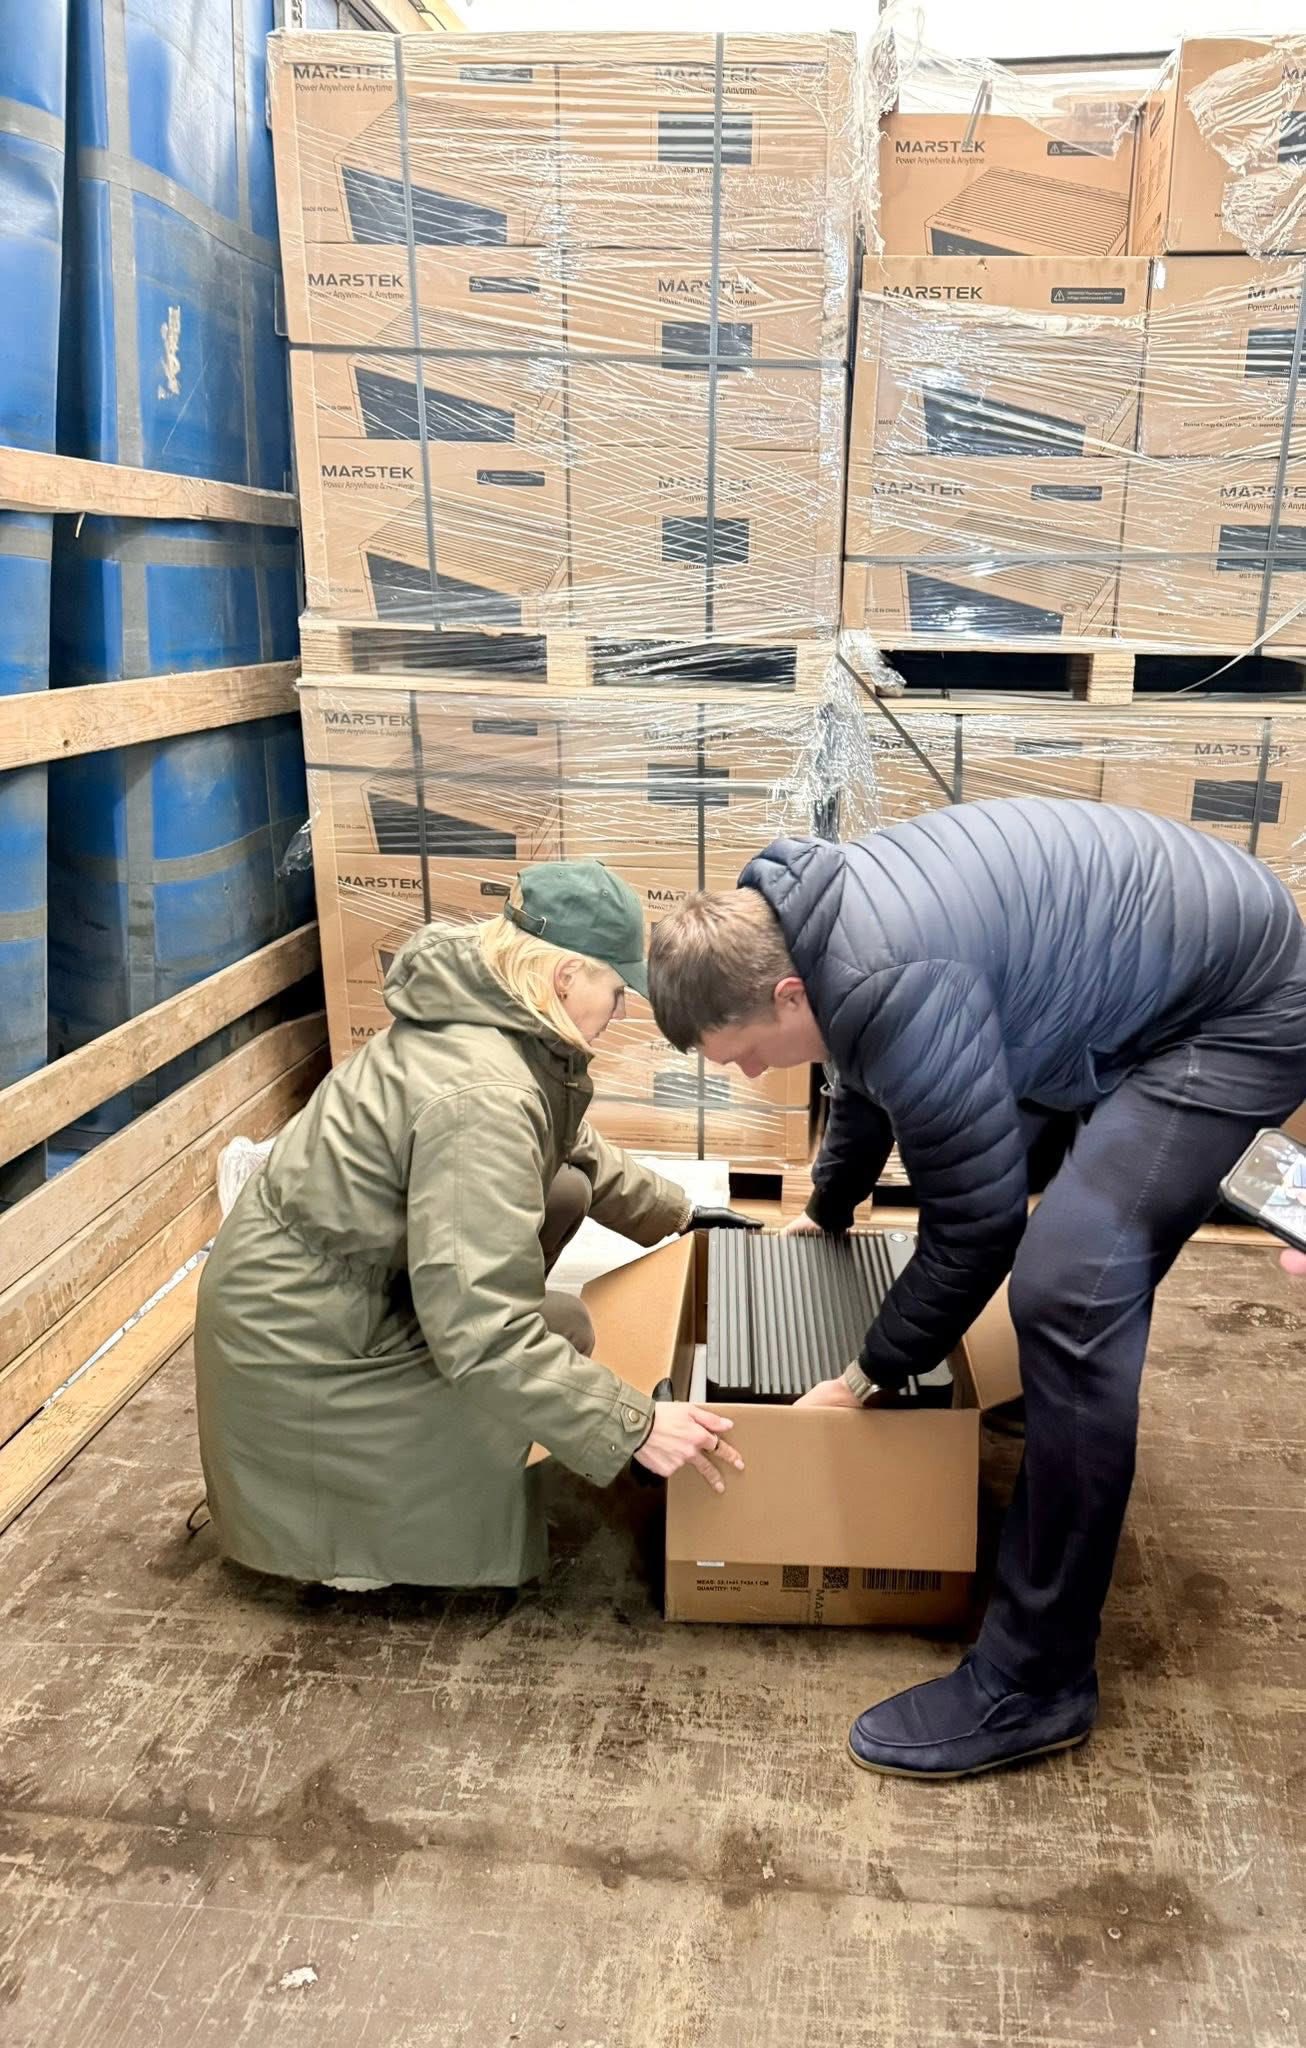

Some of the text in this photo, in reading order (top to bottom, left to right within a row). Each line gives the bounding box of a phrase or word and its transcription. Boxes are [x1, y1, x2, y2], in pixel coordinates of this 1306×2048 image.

[295, 83, 318, 92] Power
[319, 83, 355, 94] Anywhere
[363, 83, 393, 94] Anytime
[896, 140, 985, 153] MARSTEK
[896, 156, 917, 165] Power
[917, 156, 951, 167] Anywhere
[957, 156, 985, 167] Anytime
[308, 273, 404, 288] MARSTEK
[883, 285, 983, 300] MARSTEK
[321, 465, 415, 480] MARSTEK
[323, 480, 346, 489] Power
[324, 711, 414, 726] MARSTEK
[338, 875, 424, 889] MARSTEK
